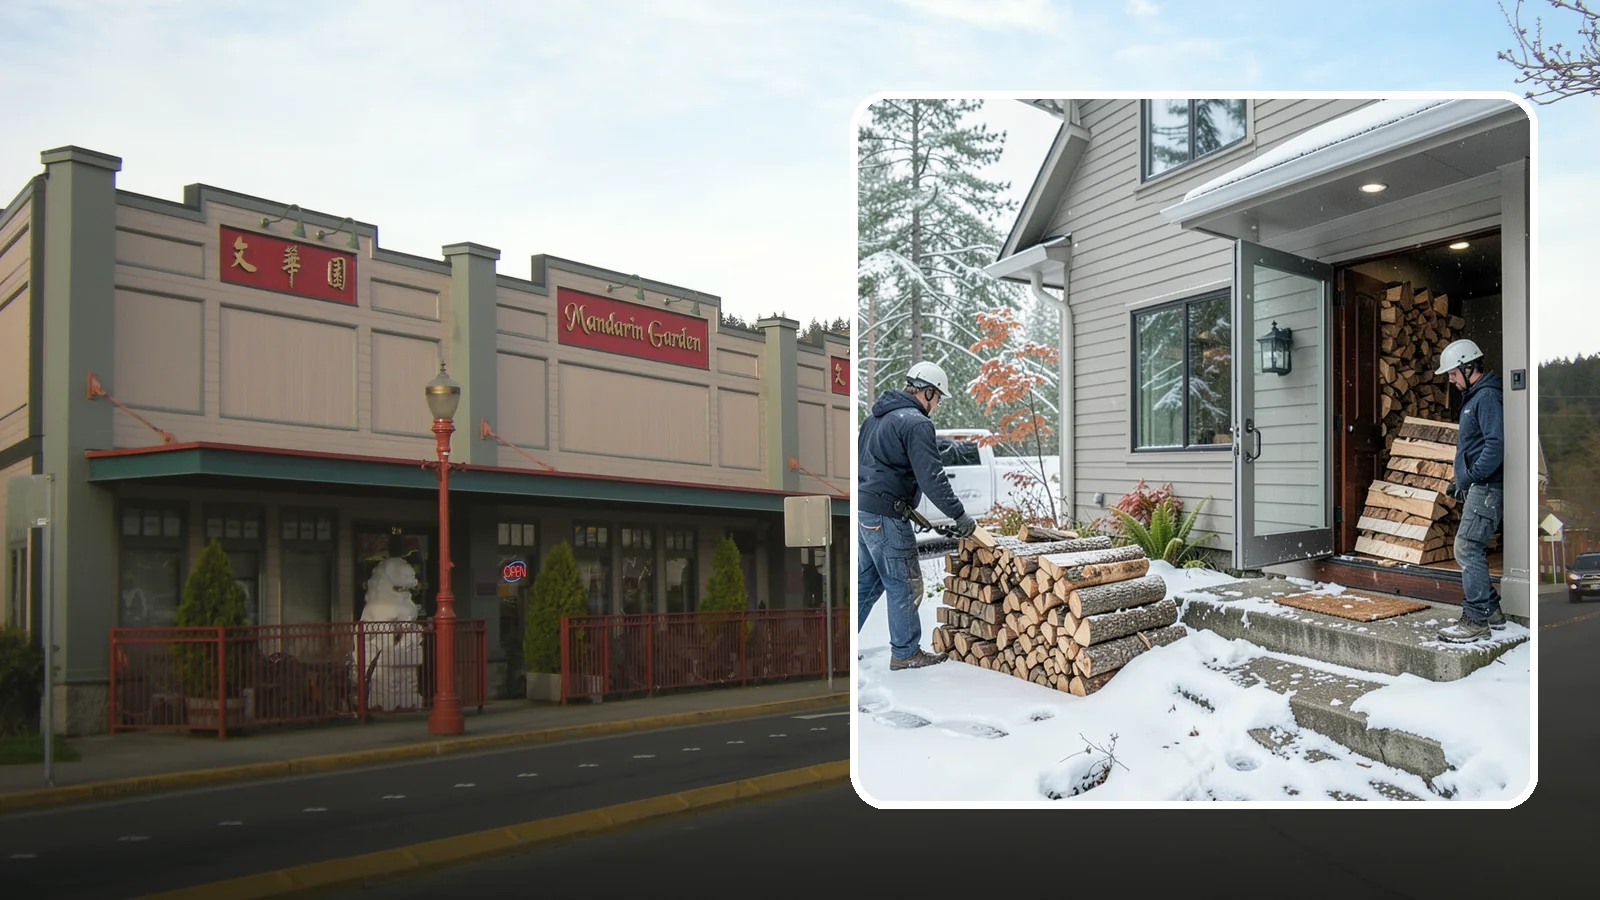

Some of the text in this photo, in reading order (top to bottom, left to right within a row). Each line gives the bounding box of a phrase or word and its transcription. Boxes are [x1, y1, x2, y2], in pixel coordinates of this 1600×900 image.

[231, 236, 347, 290] 文華園
[564, 302, 702, 352] Mandarin Garden
[503, 565, 527, 578] OPEN
